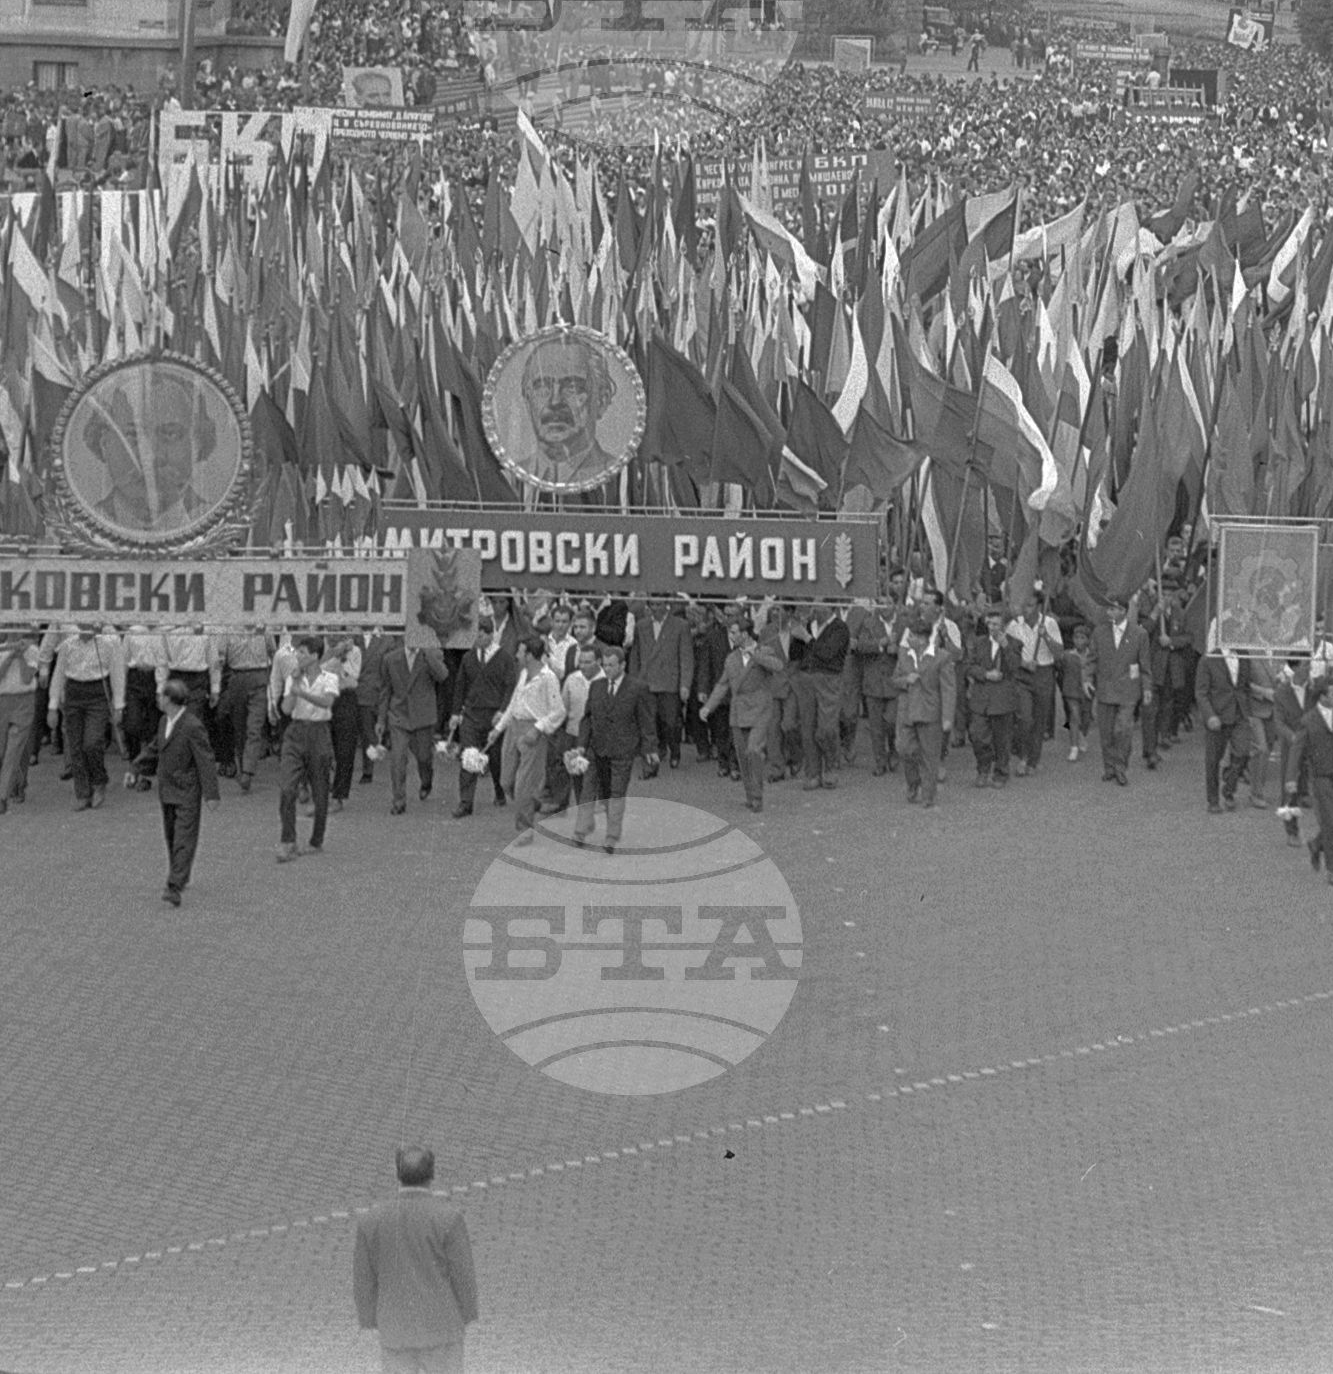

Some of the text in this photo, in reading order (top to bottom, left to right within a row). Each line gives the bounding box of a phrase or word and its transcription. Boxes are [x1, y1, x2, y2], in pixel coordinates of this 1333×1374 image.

[814, 153, 868, 169] БКП
[673, 530, 817, 581] РАЙОН
[243, 562, 403, 613] РАЙОН
